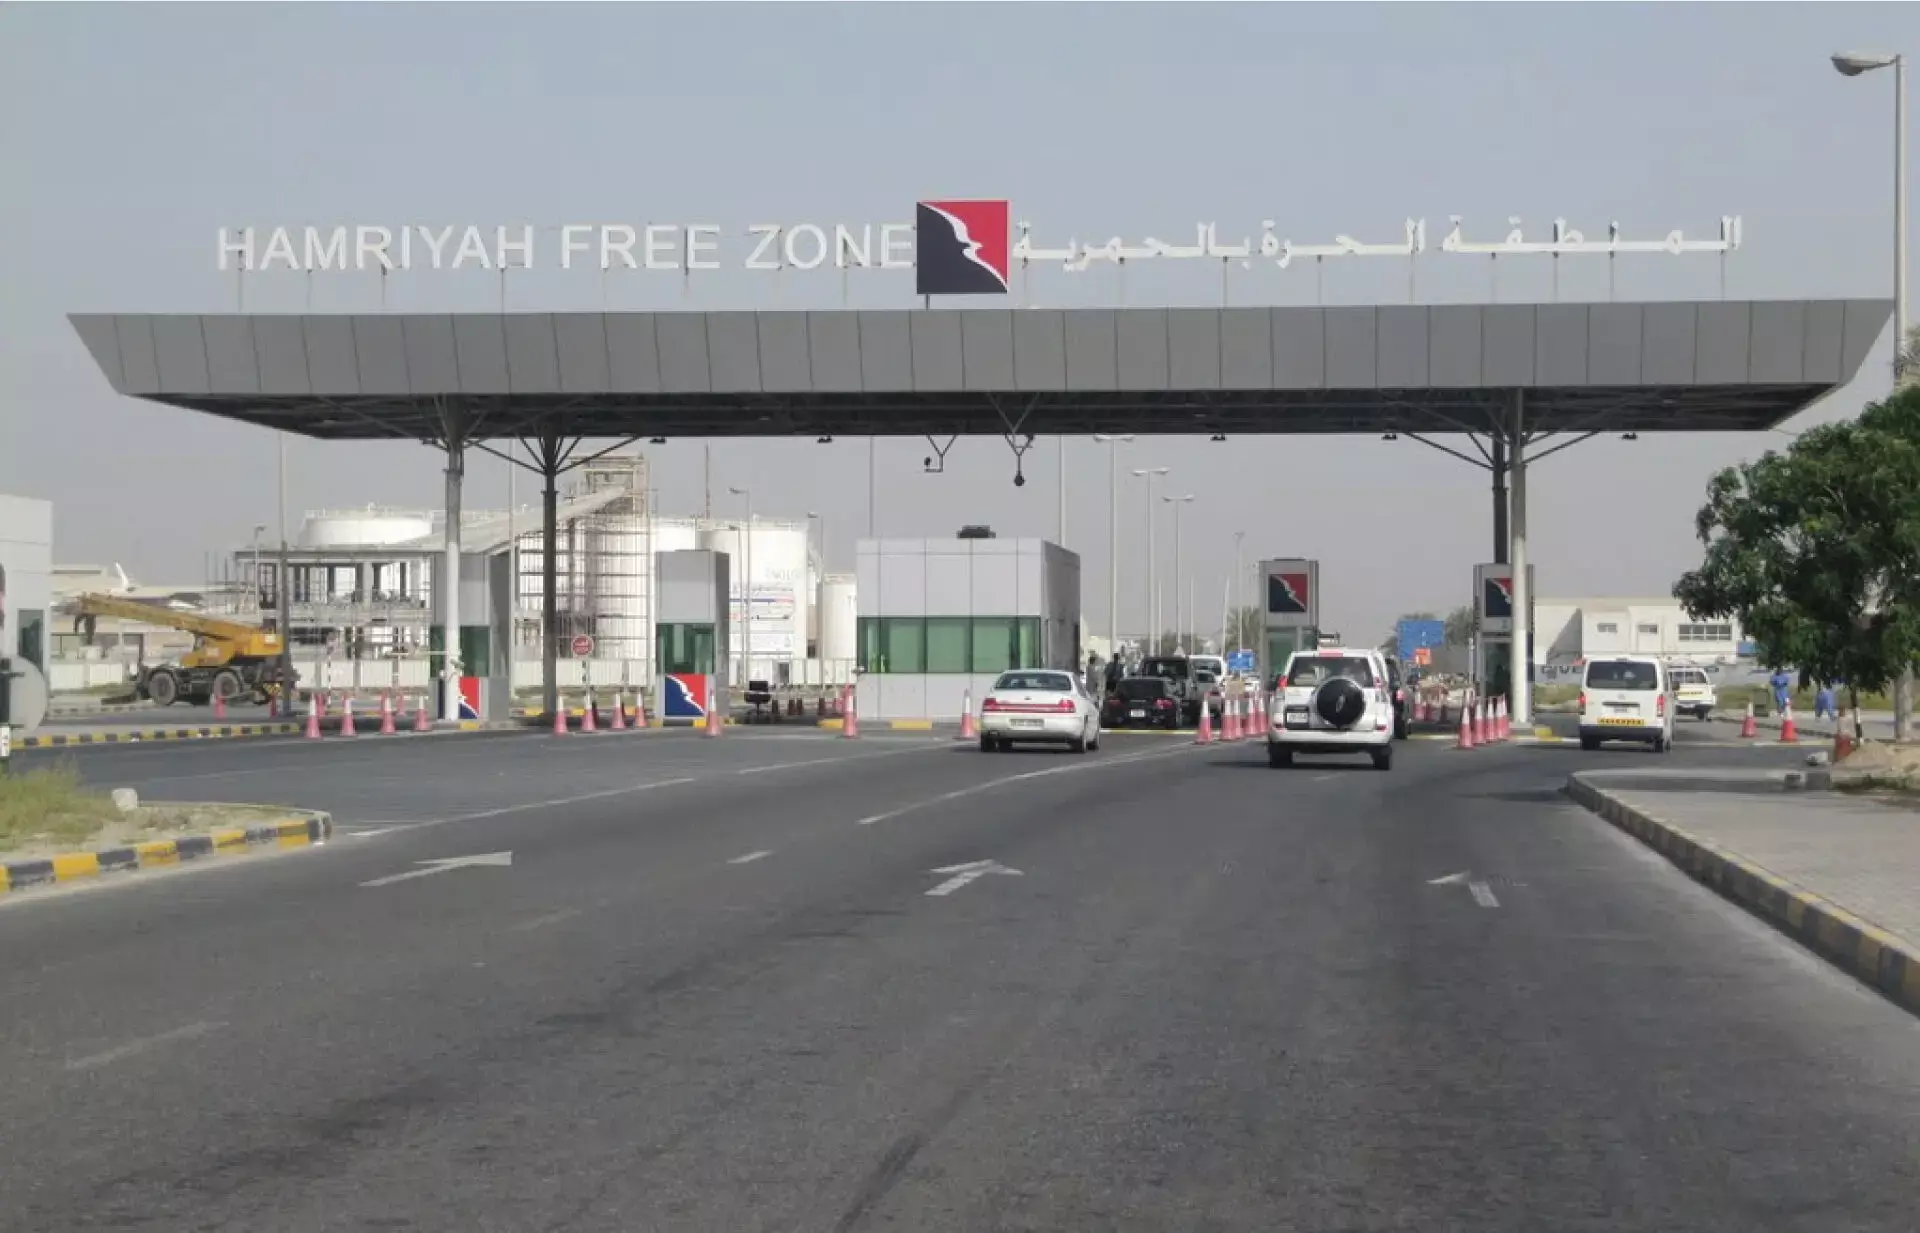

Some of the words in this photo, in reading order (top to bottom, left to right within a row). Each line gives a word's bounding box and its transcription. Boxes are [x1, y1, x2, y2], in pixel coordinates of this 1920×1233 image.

[218, 226, 533, 270] HAMRIYAH
[561, 224, 720, 269] FREE
[745, 223, 913, 269] ZONE
[1013, 218, 1250, 272] بالحمرية
[1259, 216, 1425, 269] الحرة
[1443, 214, 1742, 255] المنطقة
